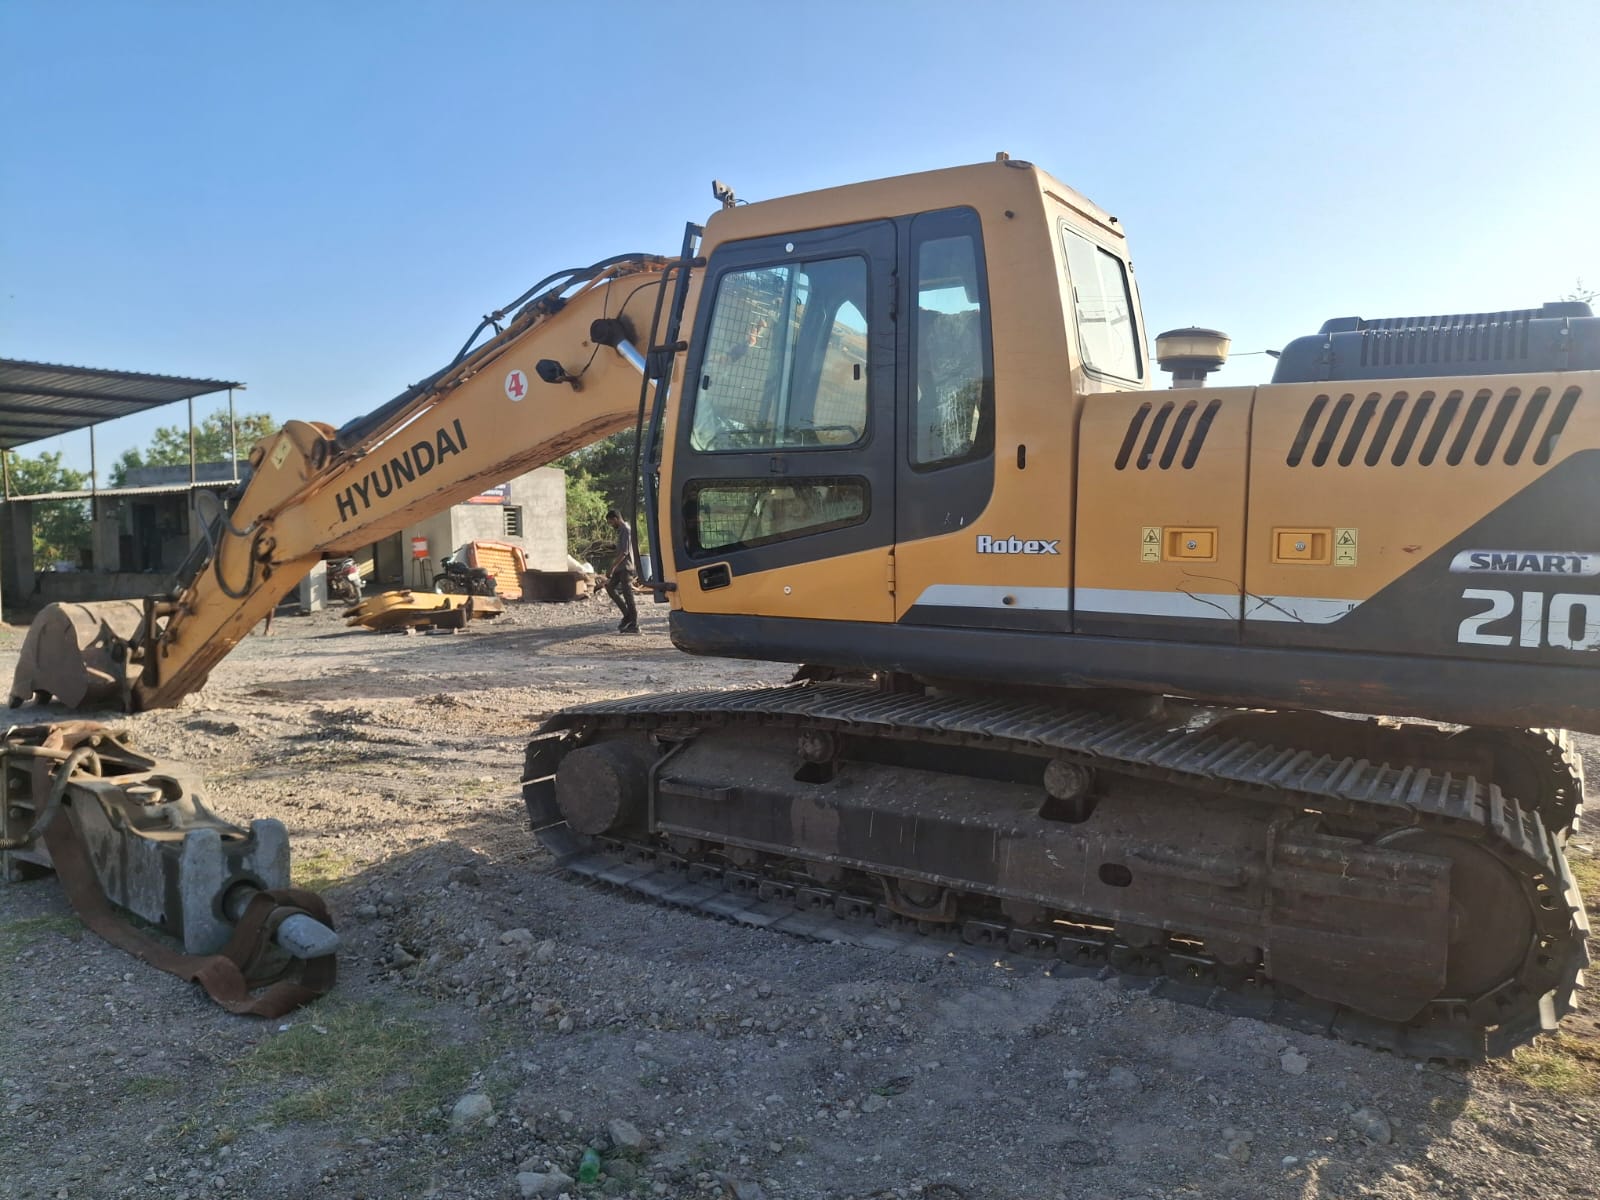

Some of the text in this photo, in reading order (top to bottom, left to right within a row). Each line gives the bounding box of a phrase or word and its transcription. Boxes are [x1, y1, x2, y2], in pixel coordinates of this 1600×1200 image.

[508, 373, 523, 397] 4
[336, 419, 468, 522] HYUNDAI
[976, 535, 1060, 554] Robex
[1469, 553, 1588, 573] SMART
[1457, 588, 1600, 651] 210
